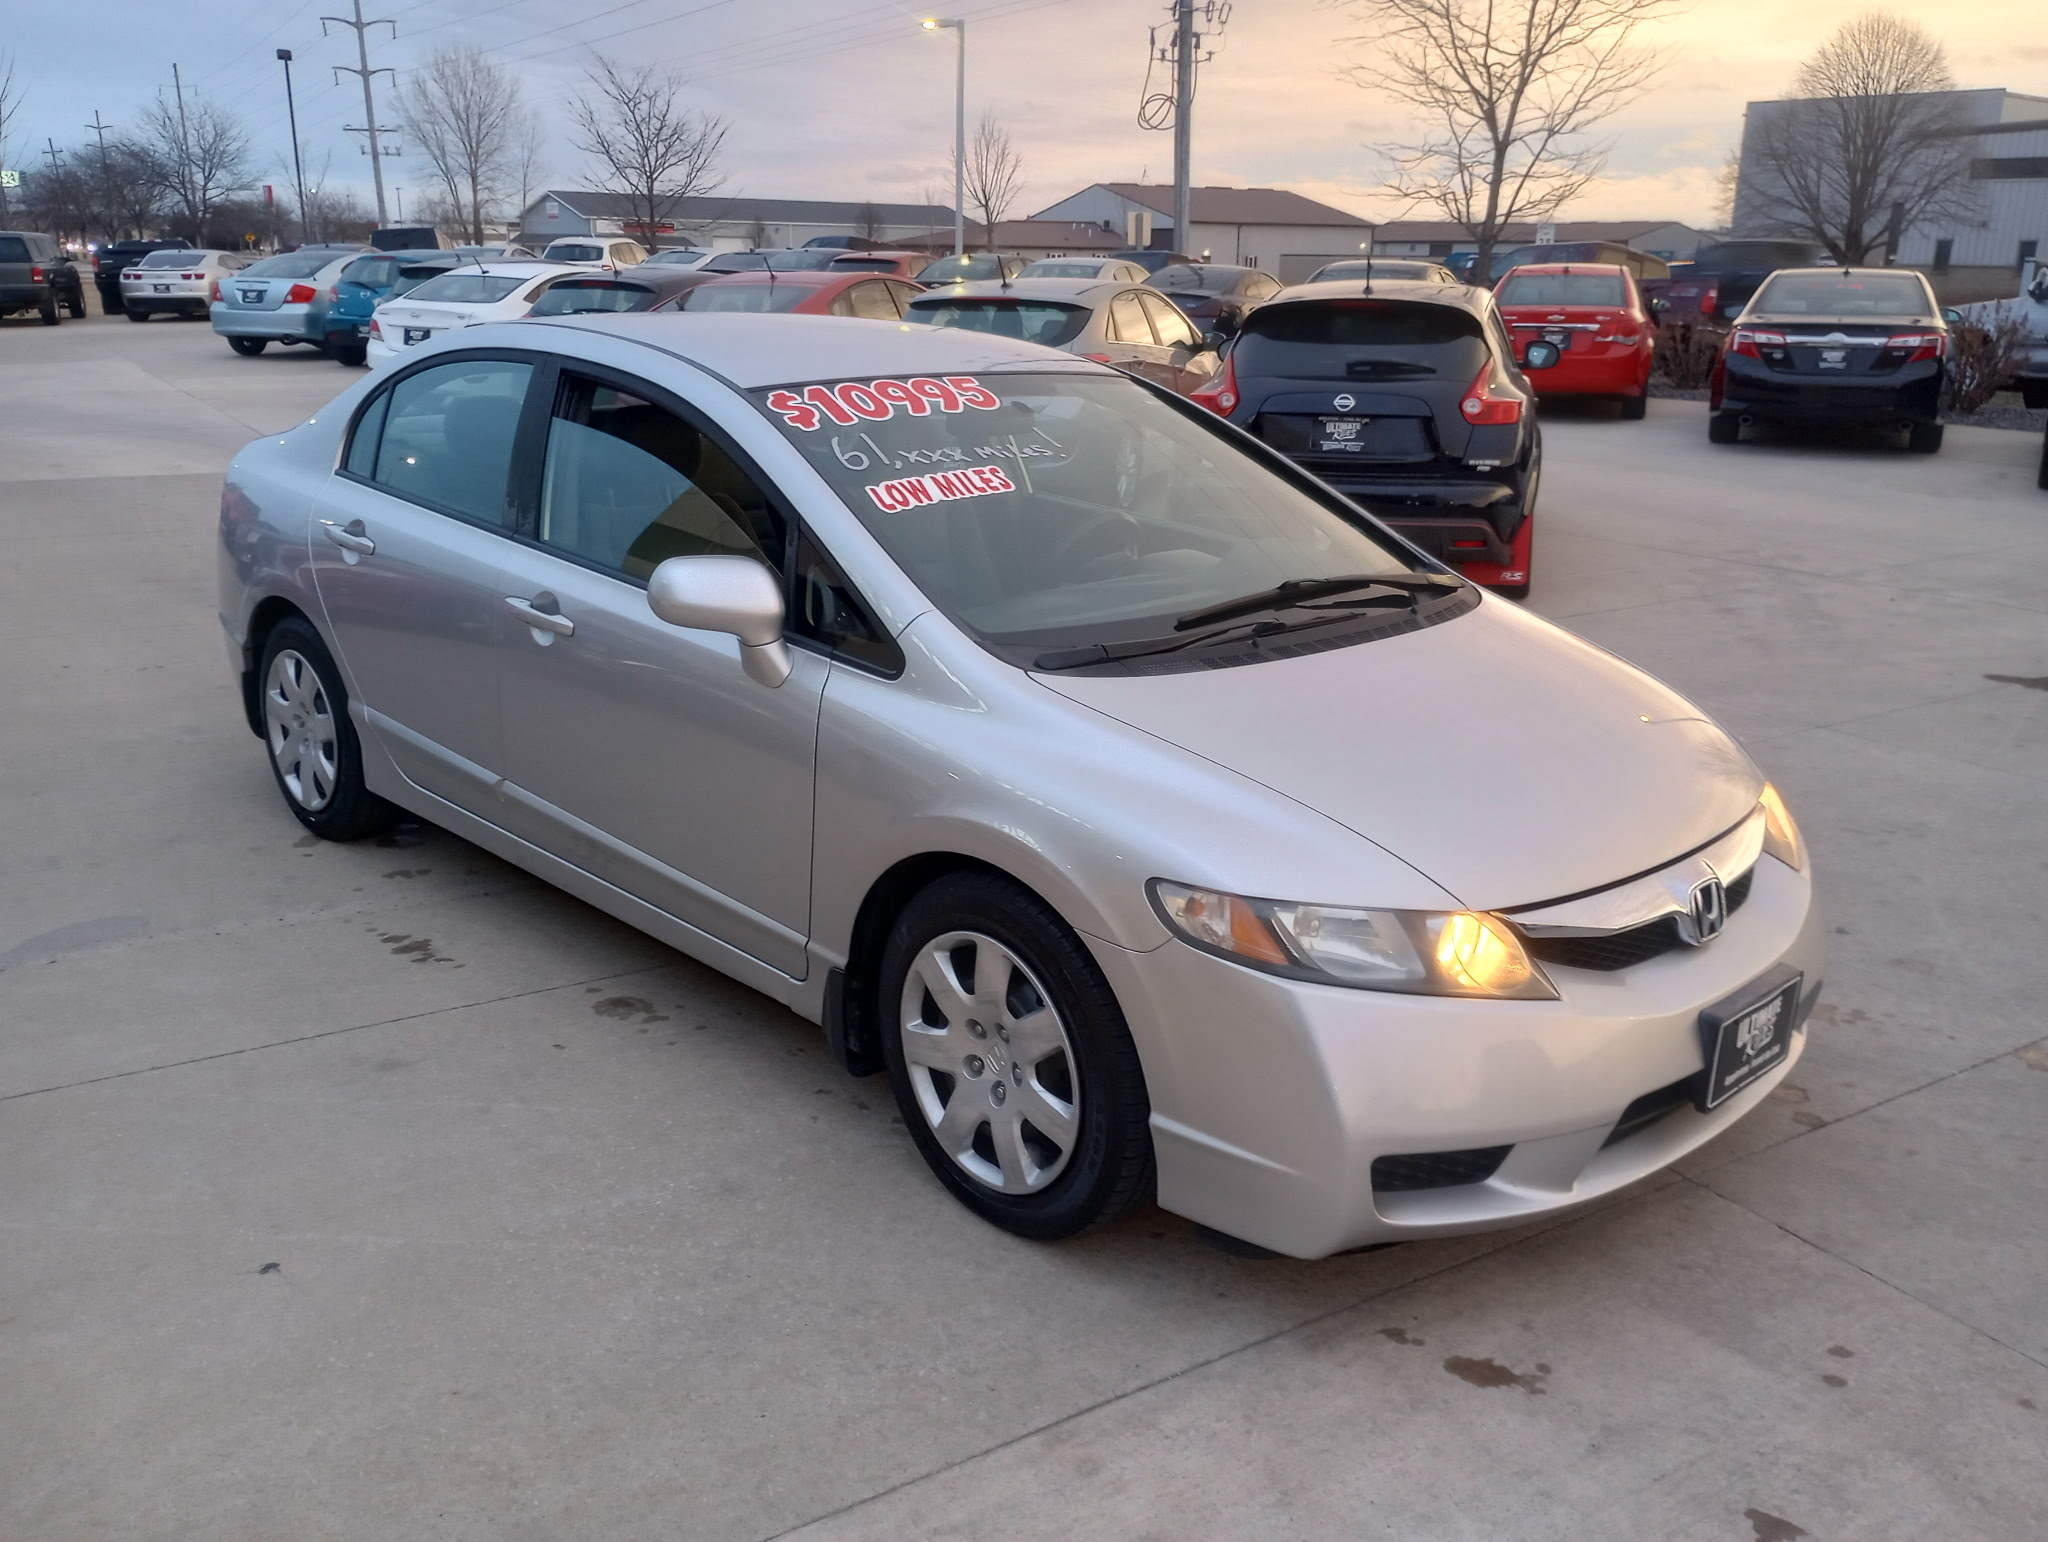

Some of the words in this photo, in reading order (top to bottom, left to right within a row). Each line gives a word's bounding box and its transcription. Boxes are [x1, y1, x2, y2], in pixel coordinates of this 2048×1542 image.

[767, 376, 1000, 431] $10995
[866, 477, 937, 512] LOW
[927, 465, 1015, 499] MILES
